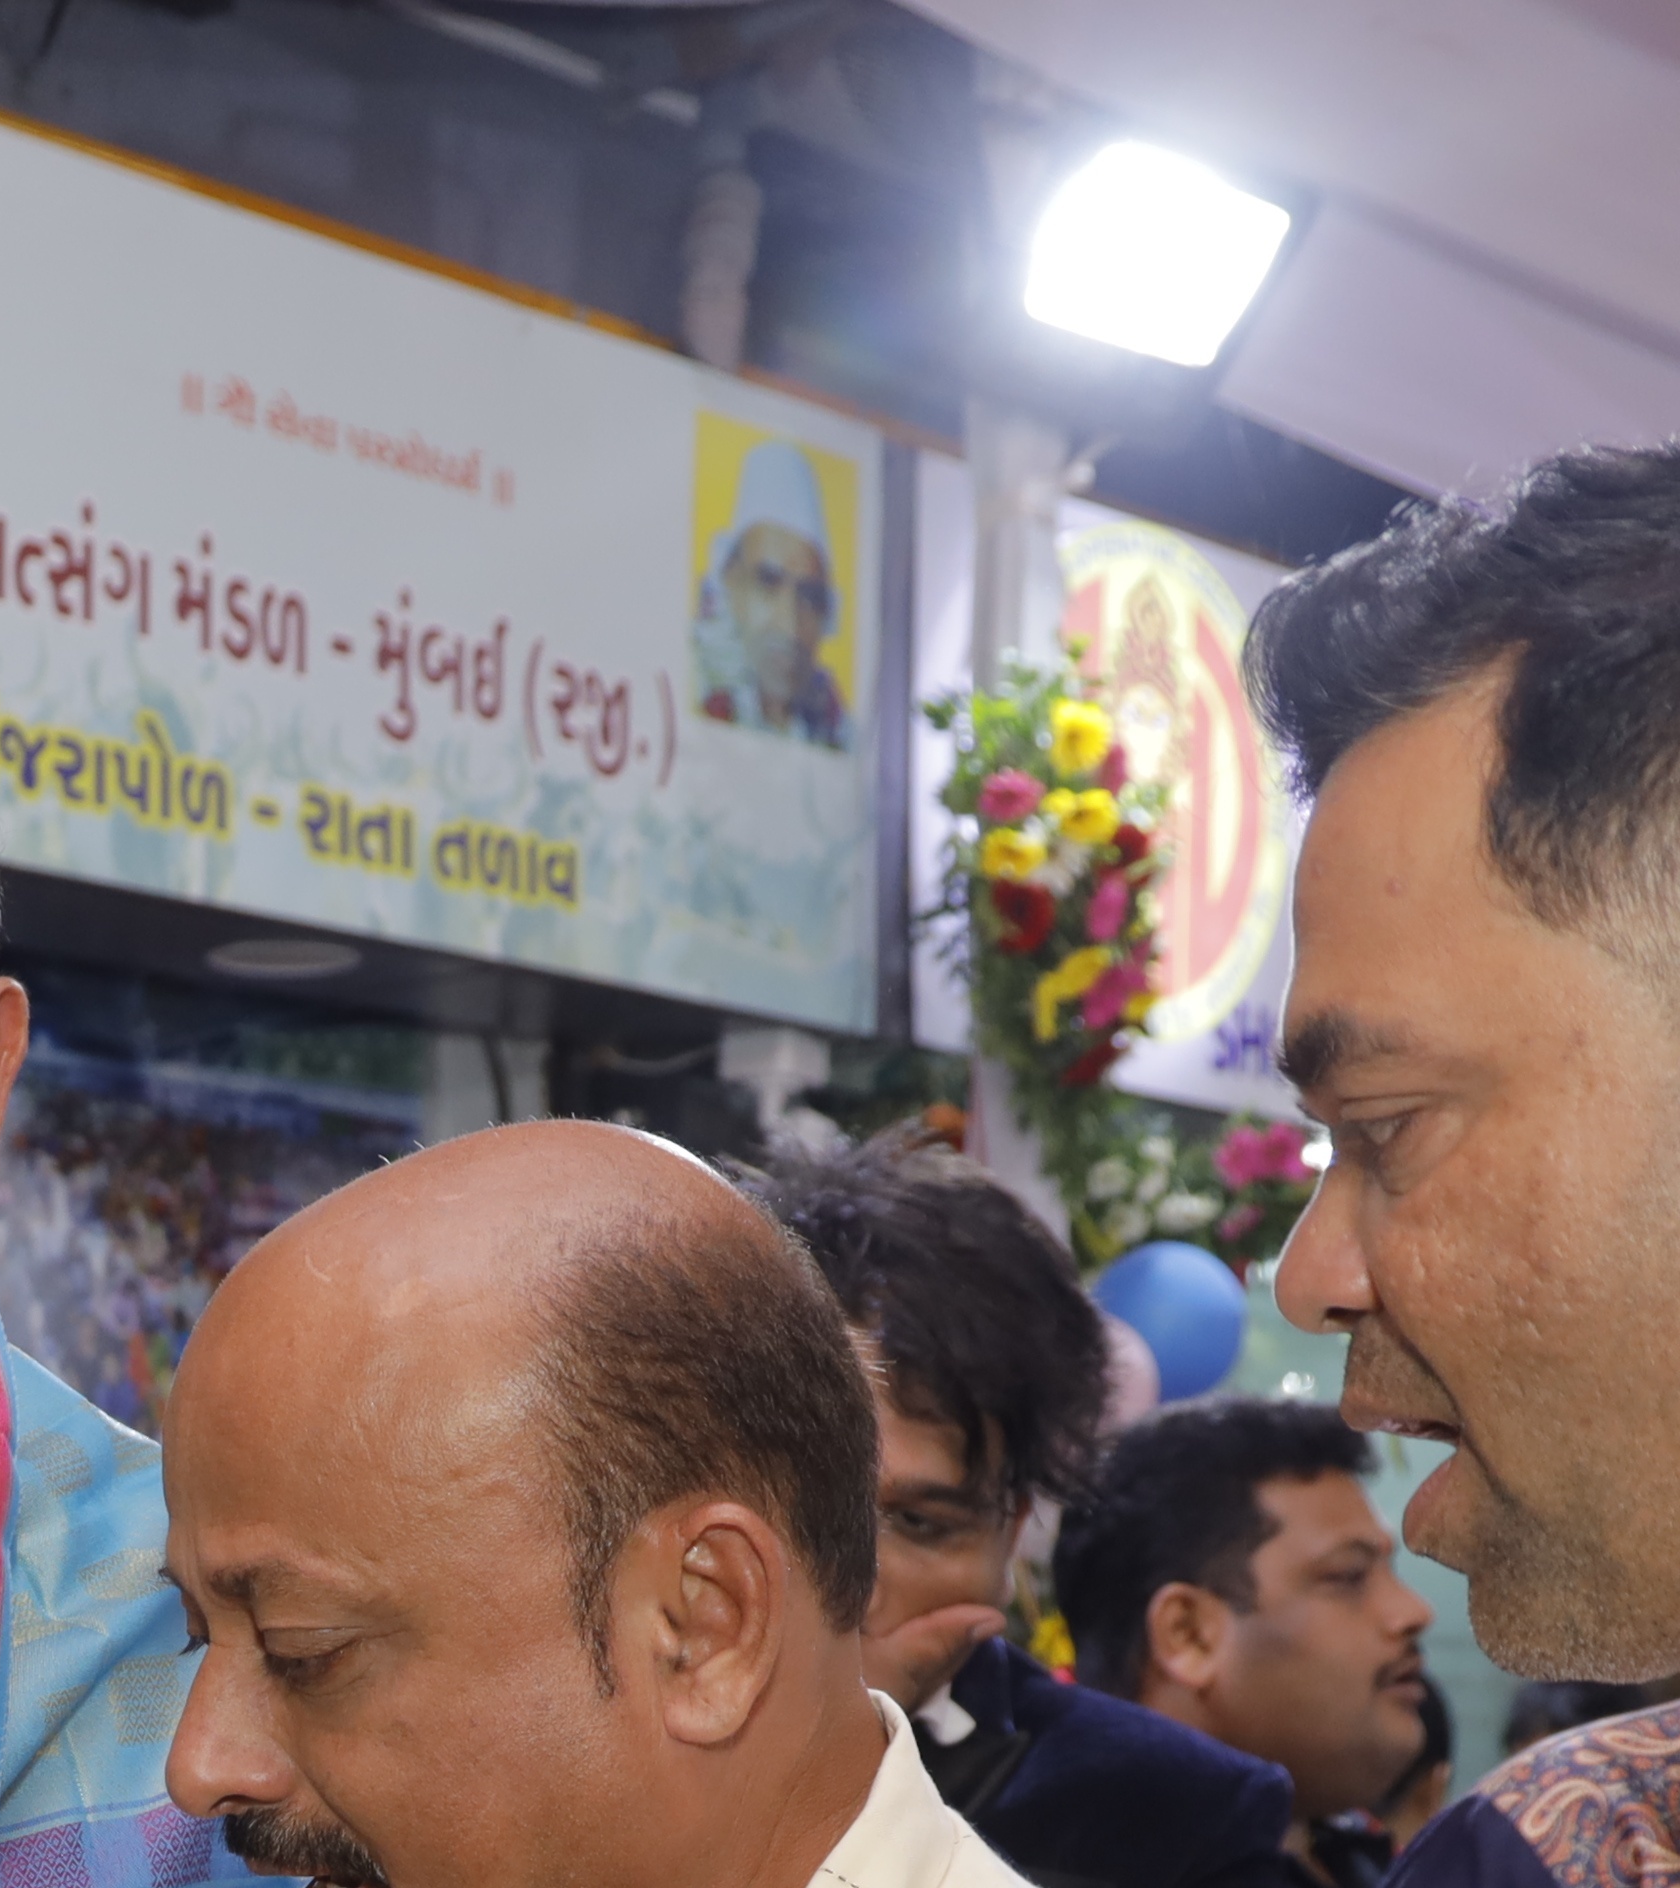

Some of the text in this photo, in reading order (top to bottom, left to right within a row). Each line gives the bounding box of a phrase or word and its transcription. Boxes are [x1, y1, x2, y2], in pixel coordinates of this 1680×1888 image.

[174, 534, 310, 674] મંડળ
[374, 584, 509, 743] મુંબઈ
[524, 636, 678, 788] (રજી.)
[300, 792, 414, 870] રાતા
[433, 823, 582, 909] તળાવ
